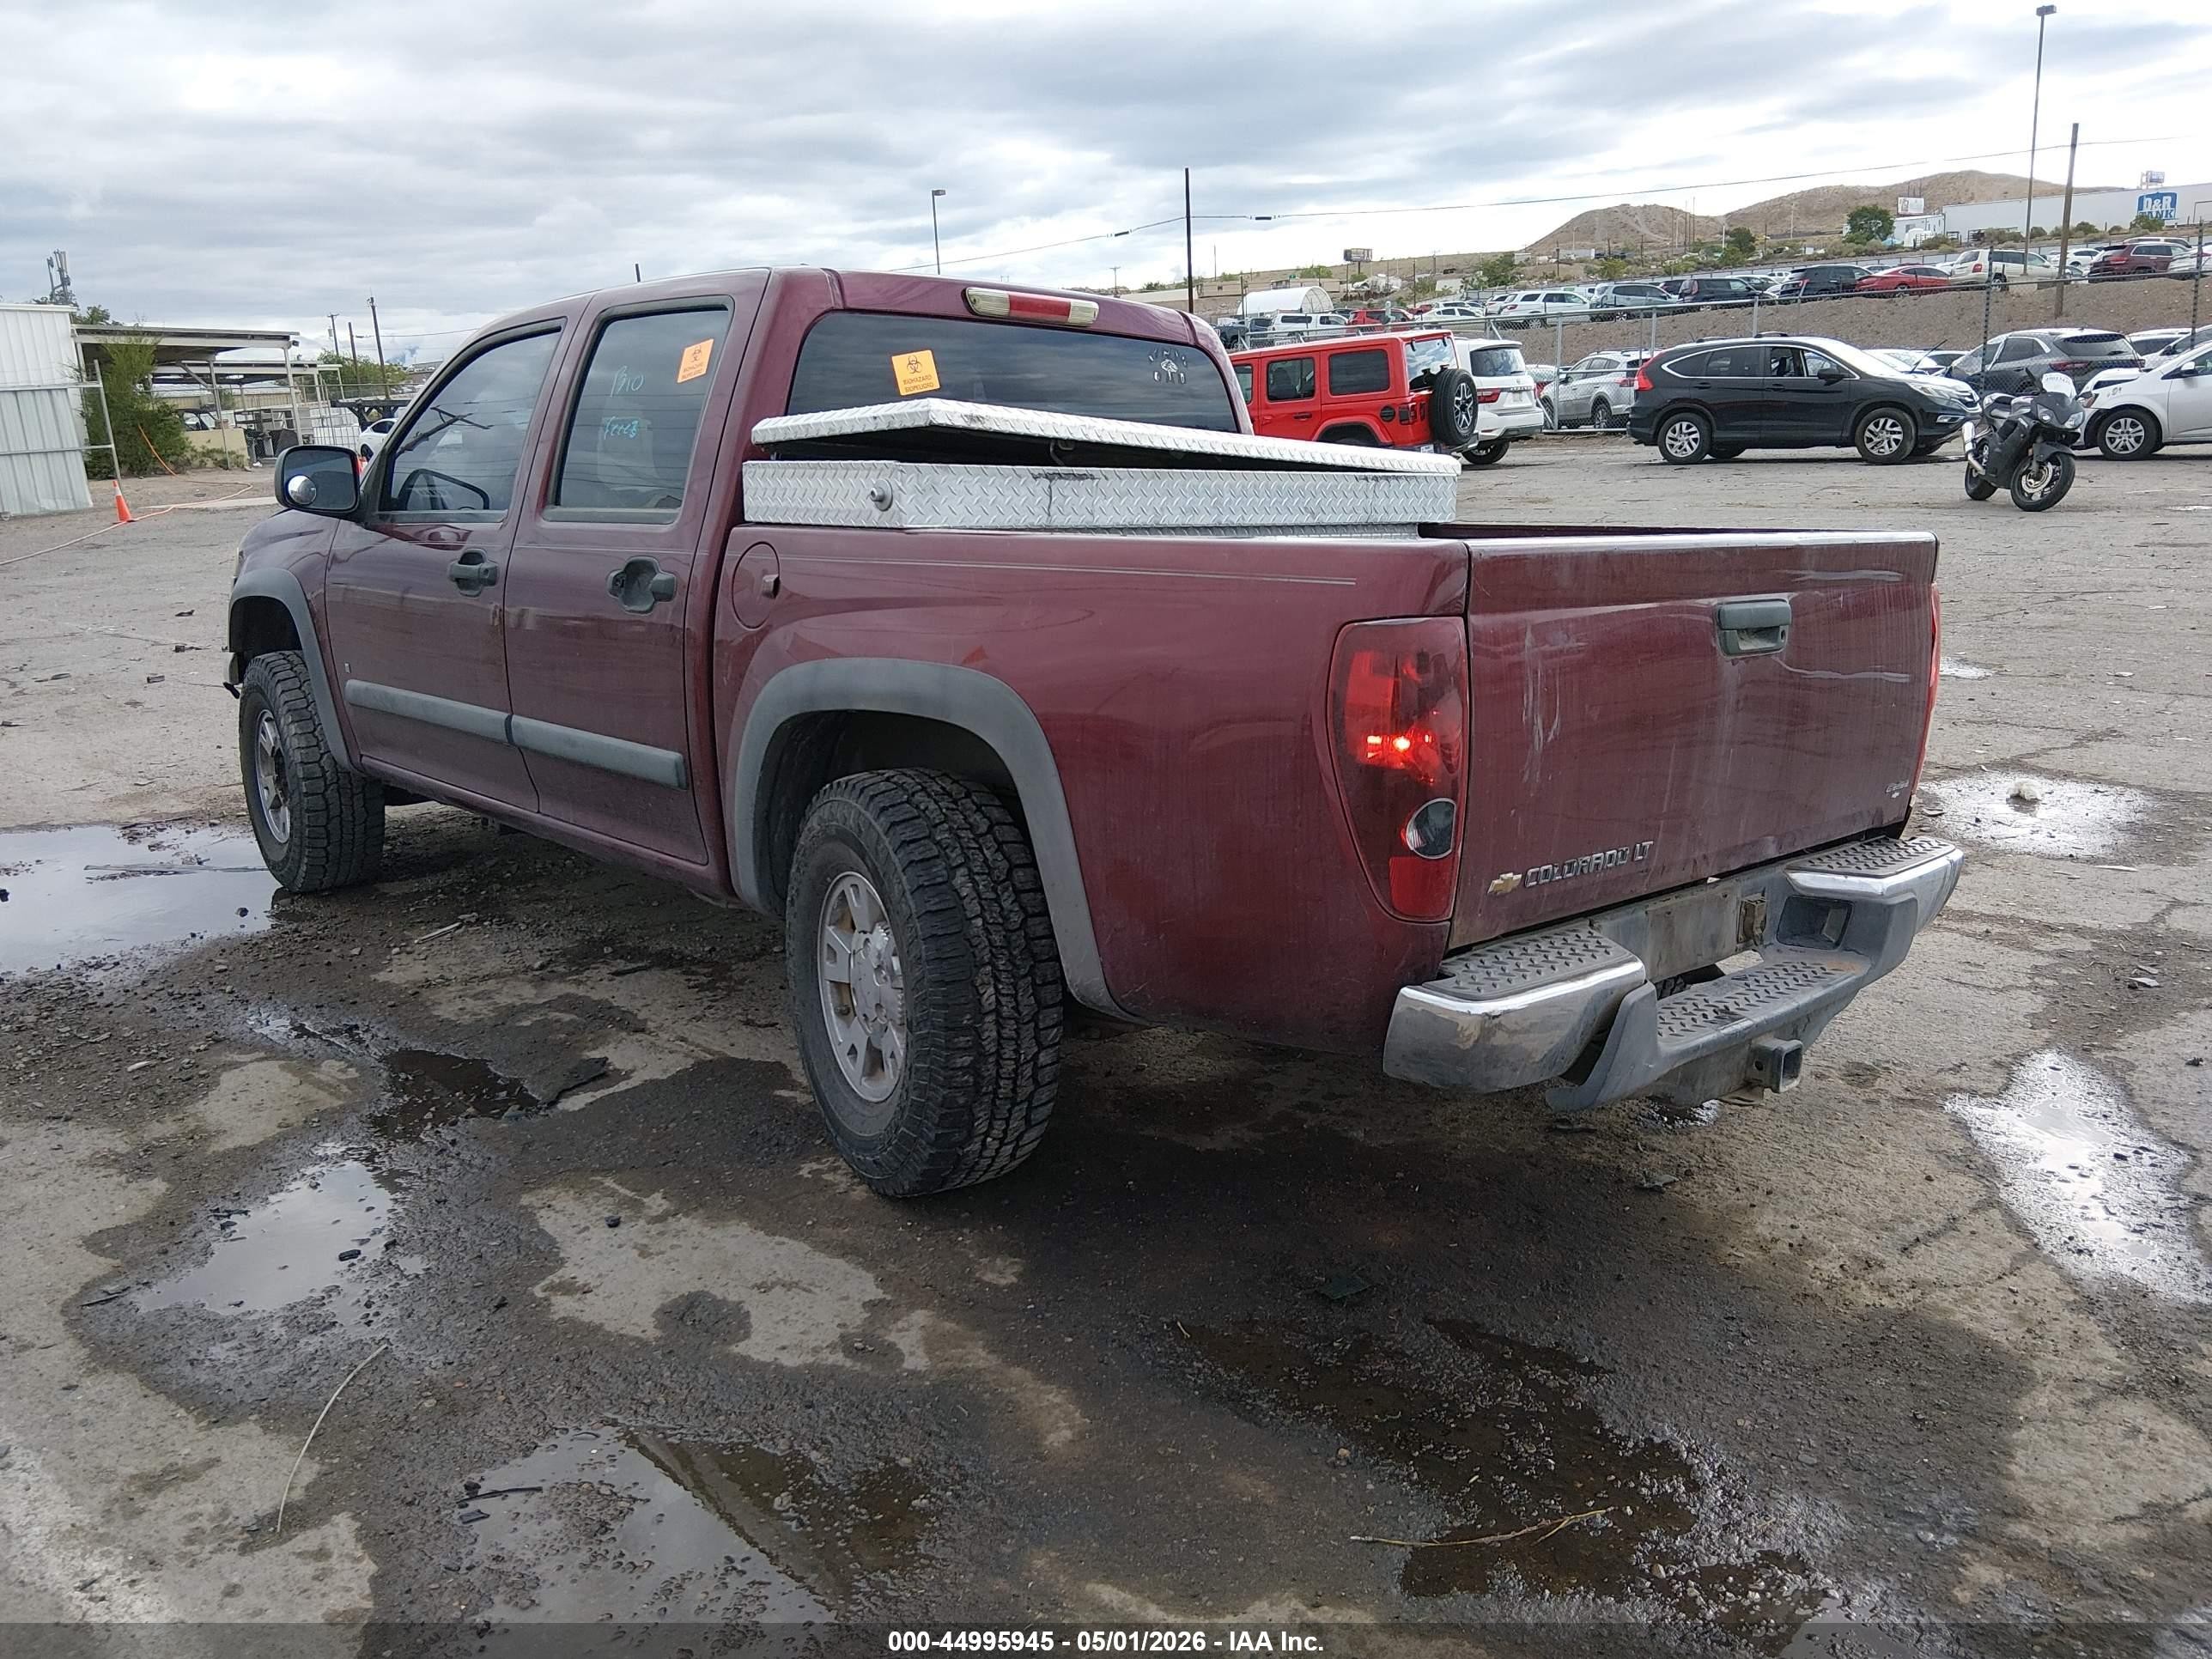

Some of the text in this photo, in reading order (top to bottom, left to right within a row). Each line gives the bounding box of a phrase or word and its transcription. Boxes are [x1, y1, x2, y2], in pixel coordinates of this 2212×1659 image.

[2142, 196, 2172, 211] D&R
[1524, 840, 1654, 888] COLORADO LT
